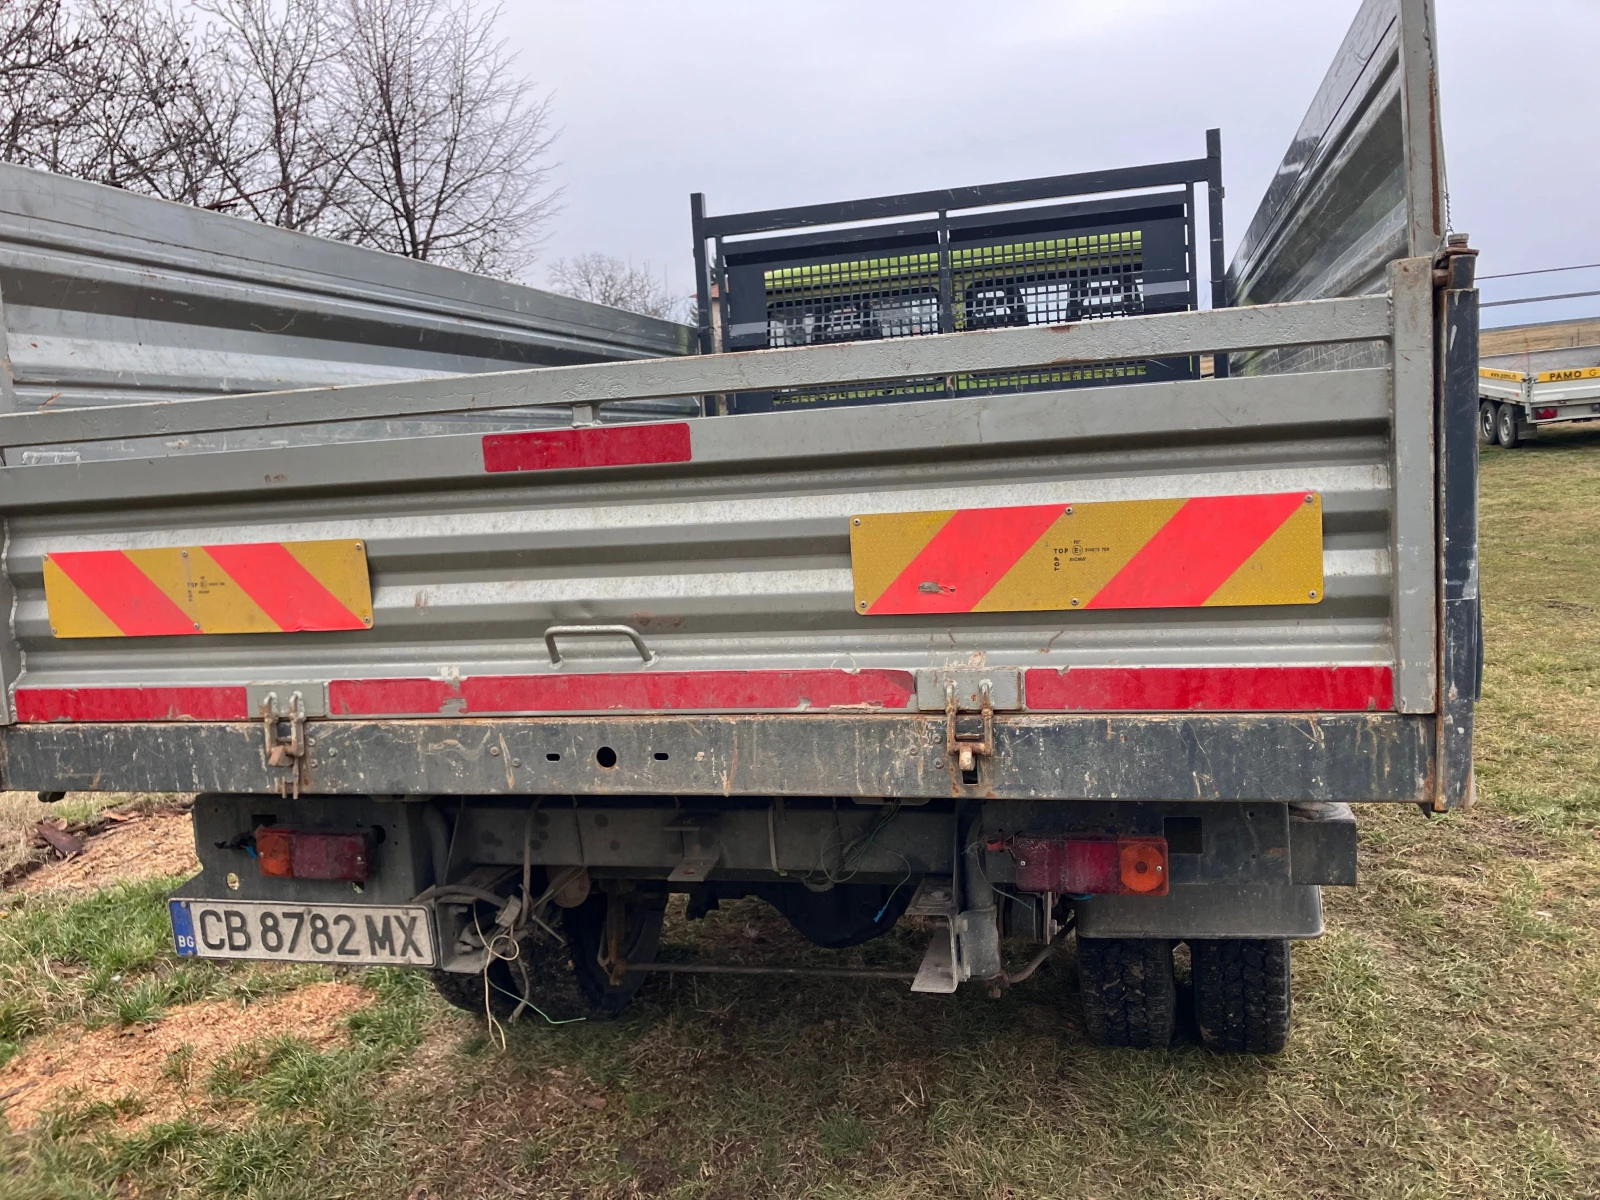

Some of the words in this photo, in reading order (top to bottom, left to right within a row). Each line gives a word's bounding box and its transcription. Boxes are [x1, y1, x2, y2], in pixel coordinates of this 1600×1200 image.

[1549, 370, 1582, 381] PAMO
[199, 909, 252, 951] CB
[258, 911, 361, 956] 8782
[365, 914, 424, 958] MX
[178, 935, 195, 948] BG
